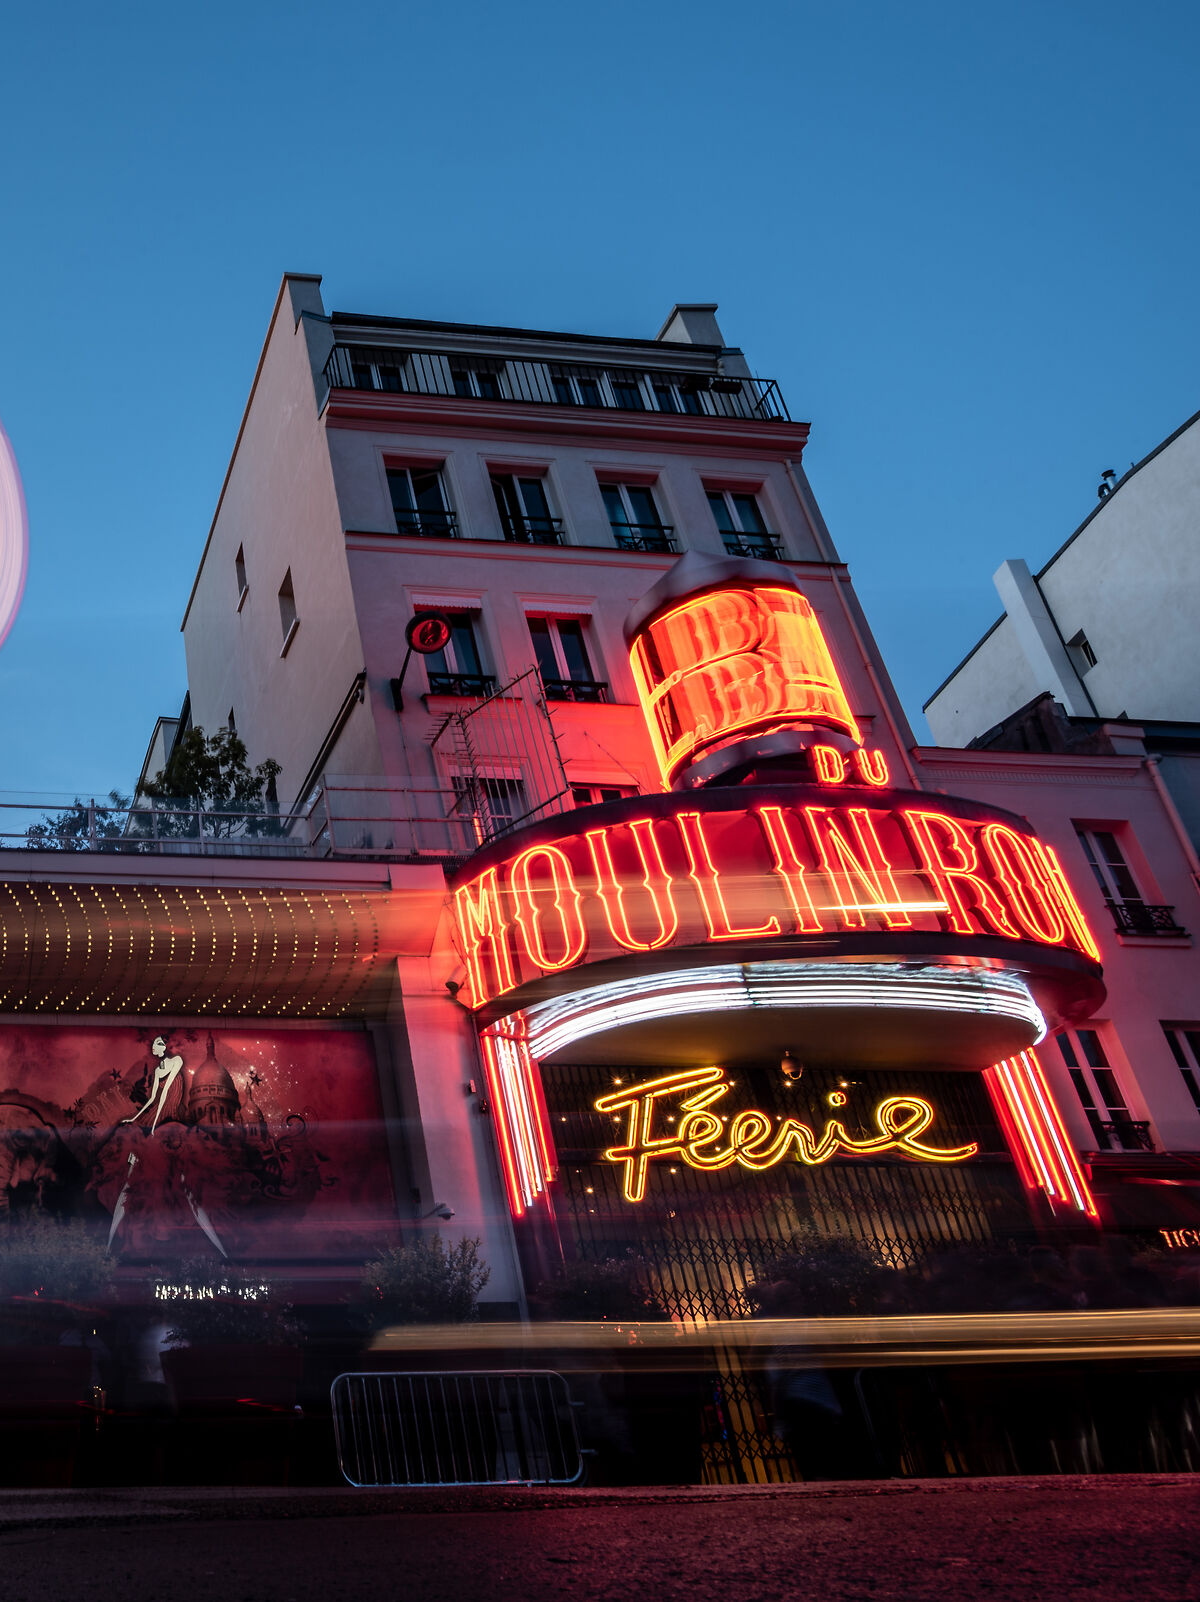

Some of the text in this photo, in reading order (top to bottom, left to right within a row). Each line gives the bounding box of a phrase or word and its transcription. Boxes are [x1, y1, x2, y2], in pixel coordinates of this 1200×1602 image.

[813, 745, 889, 787] DU
[455, 806, 912, 1009] MOULIN
[595, 1066, 978, 1202] Féerie
